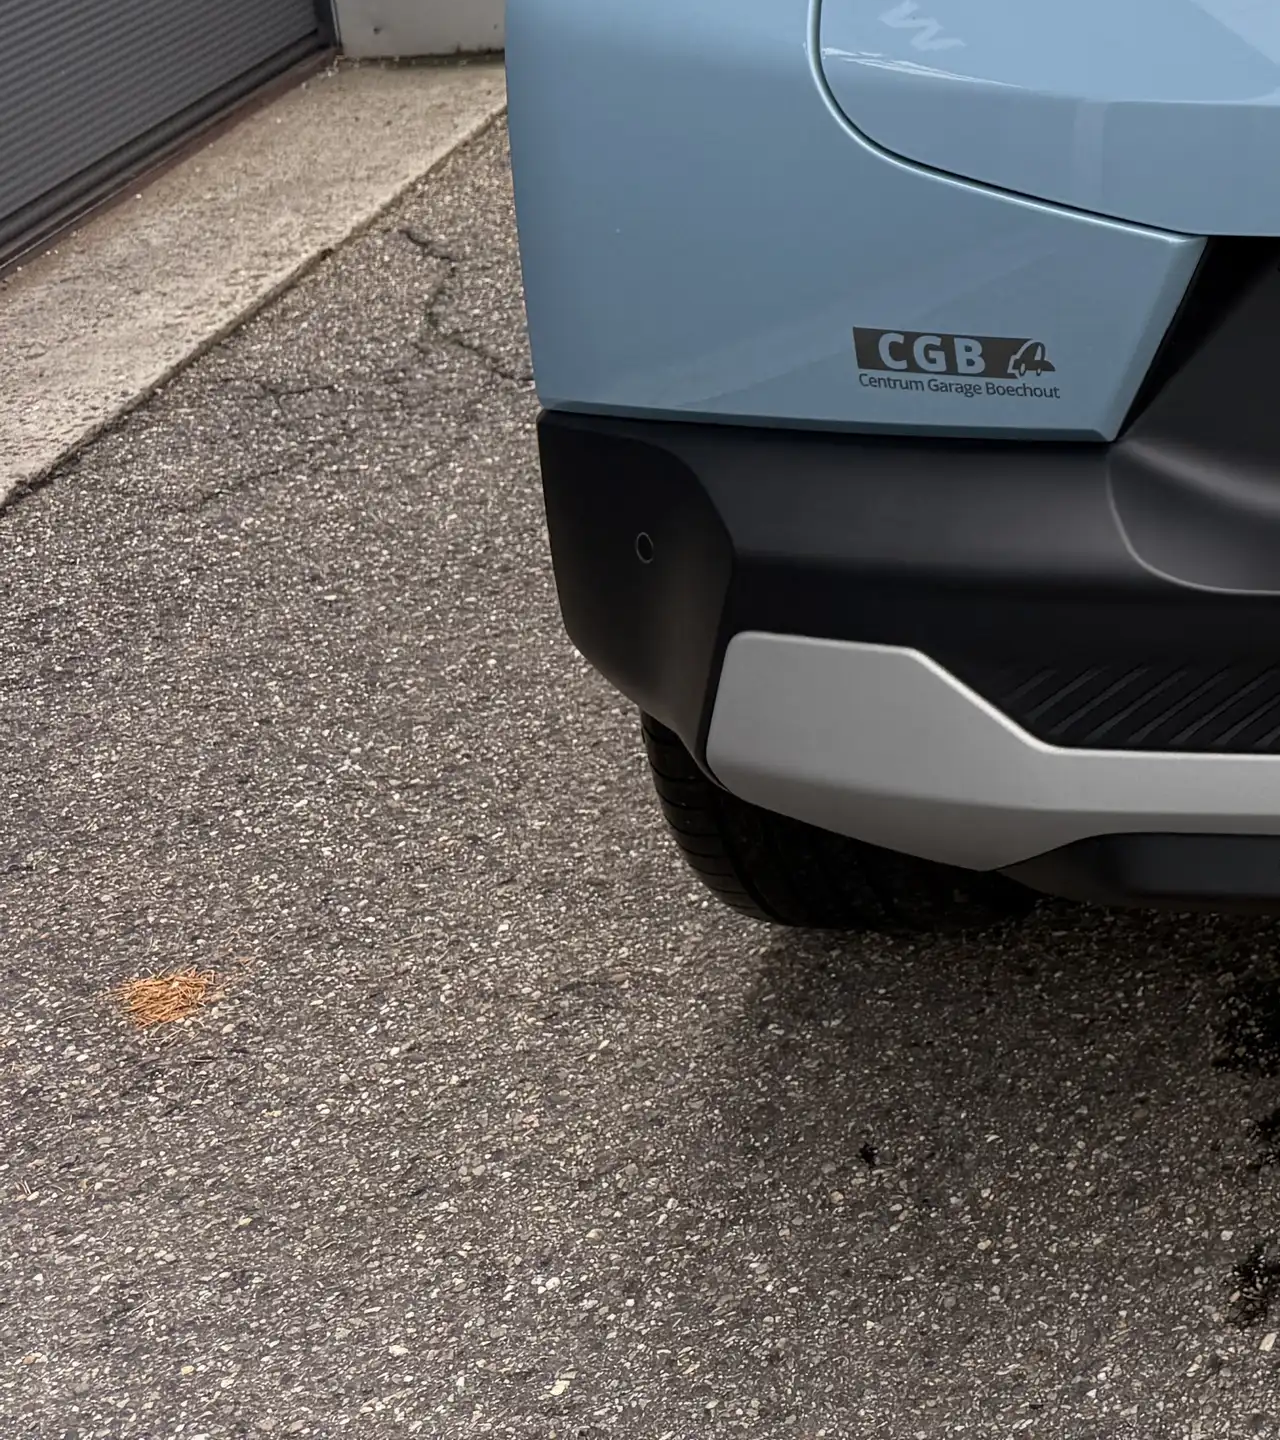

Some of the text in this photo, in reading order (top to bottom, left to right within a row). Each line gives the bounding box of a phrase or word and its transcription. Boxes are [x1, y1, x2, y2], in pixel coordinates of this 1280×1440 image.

[878, 332, 986, 375] CGB
[858, 373, 1061, 399] Centrum Garage Boechout
